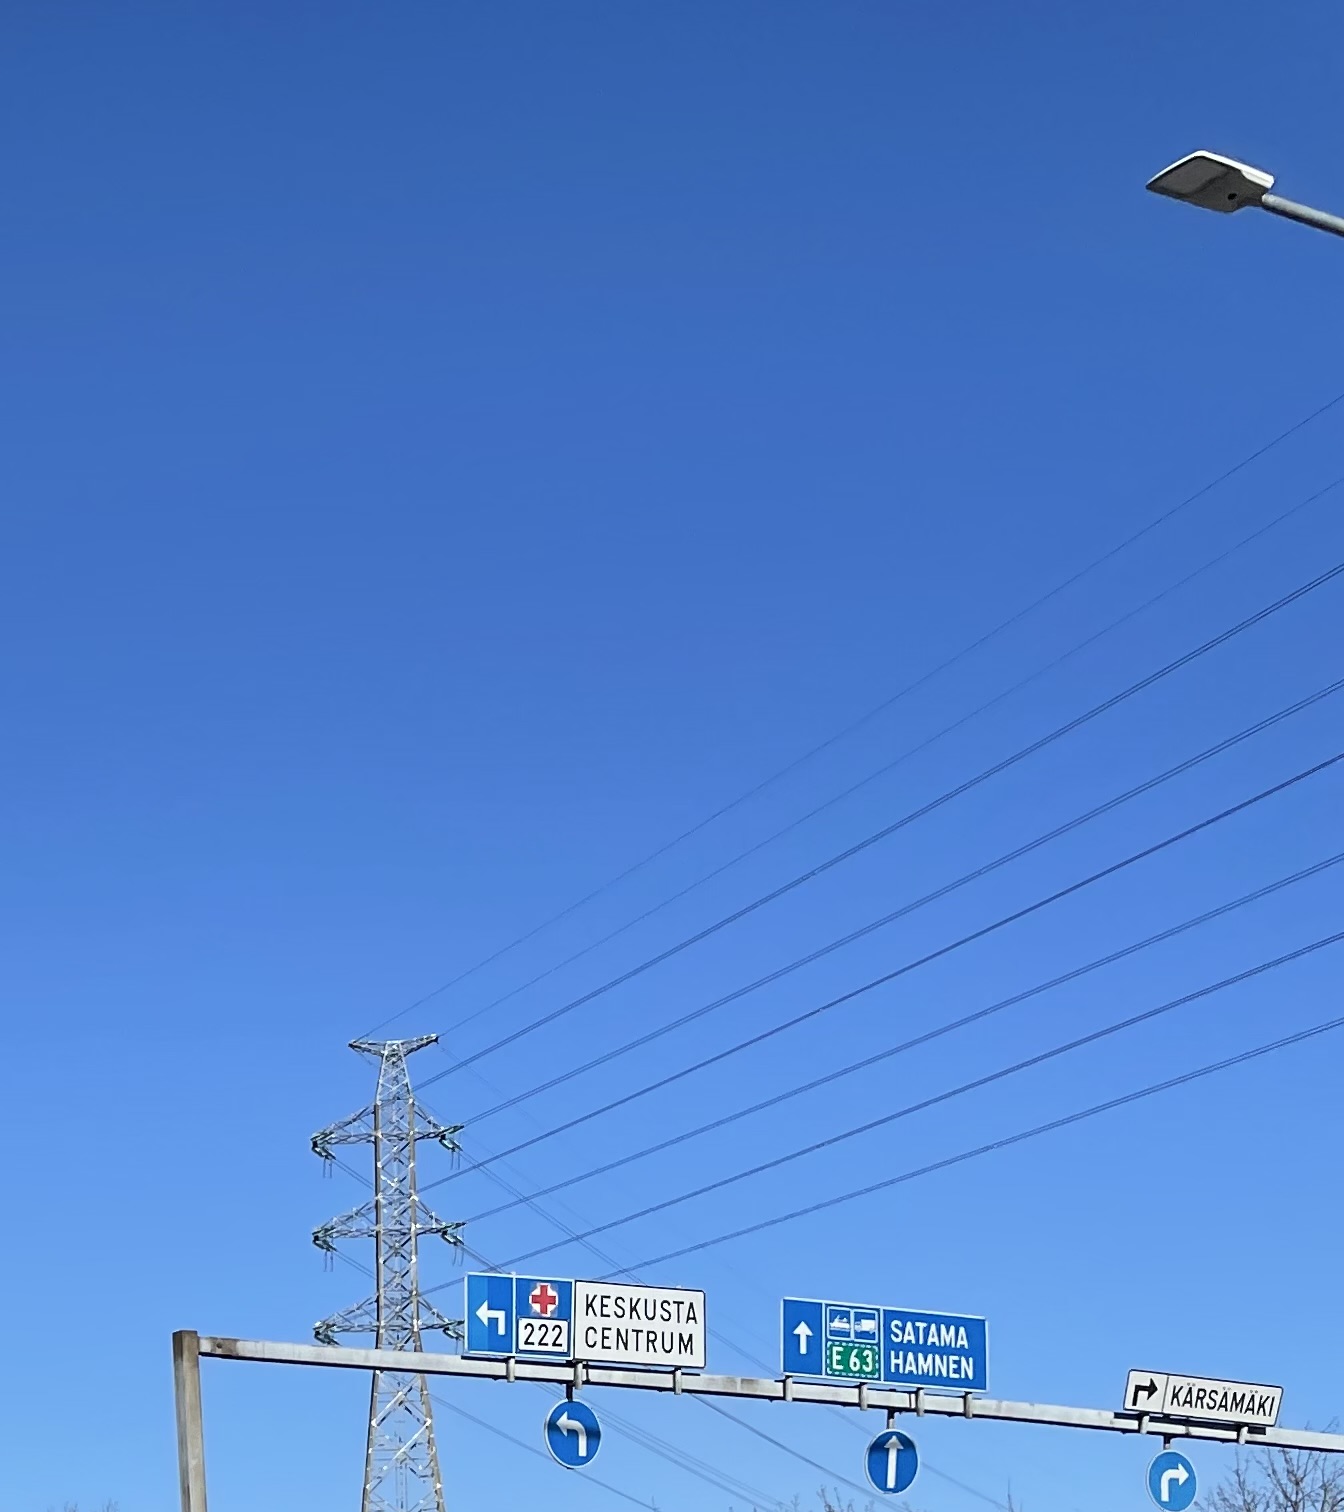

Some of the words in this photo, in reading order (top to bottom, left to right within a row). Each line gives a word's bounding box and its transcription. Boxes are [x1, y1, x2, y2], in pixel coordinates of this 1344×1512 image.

[585, 1293, 698, 1324] KESKUSTA
[524, 1323, 563, 1347] 222
[585, 1326, 694, 1355] CENTRUM
[890, 1319, 969, 1349] SATAMA
[832, 1347, 844, 1370] E
[849, 1349, 873, 1372] 63
[890, 1350, 973, 1380] HAMNEN
[1170, 1382, 1276, 1417] KÄRSÄMÄKI
